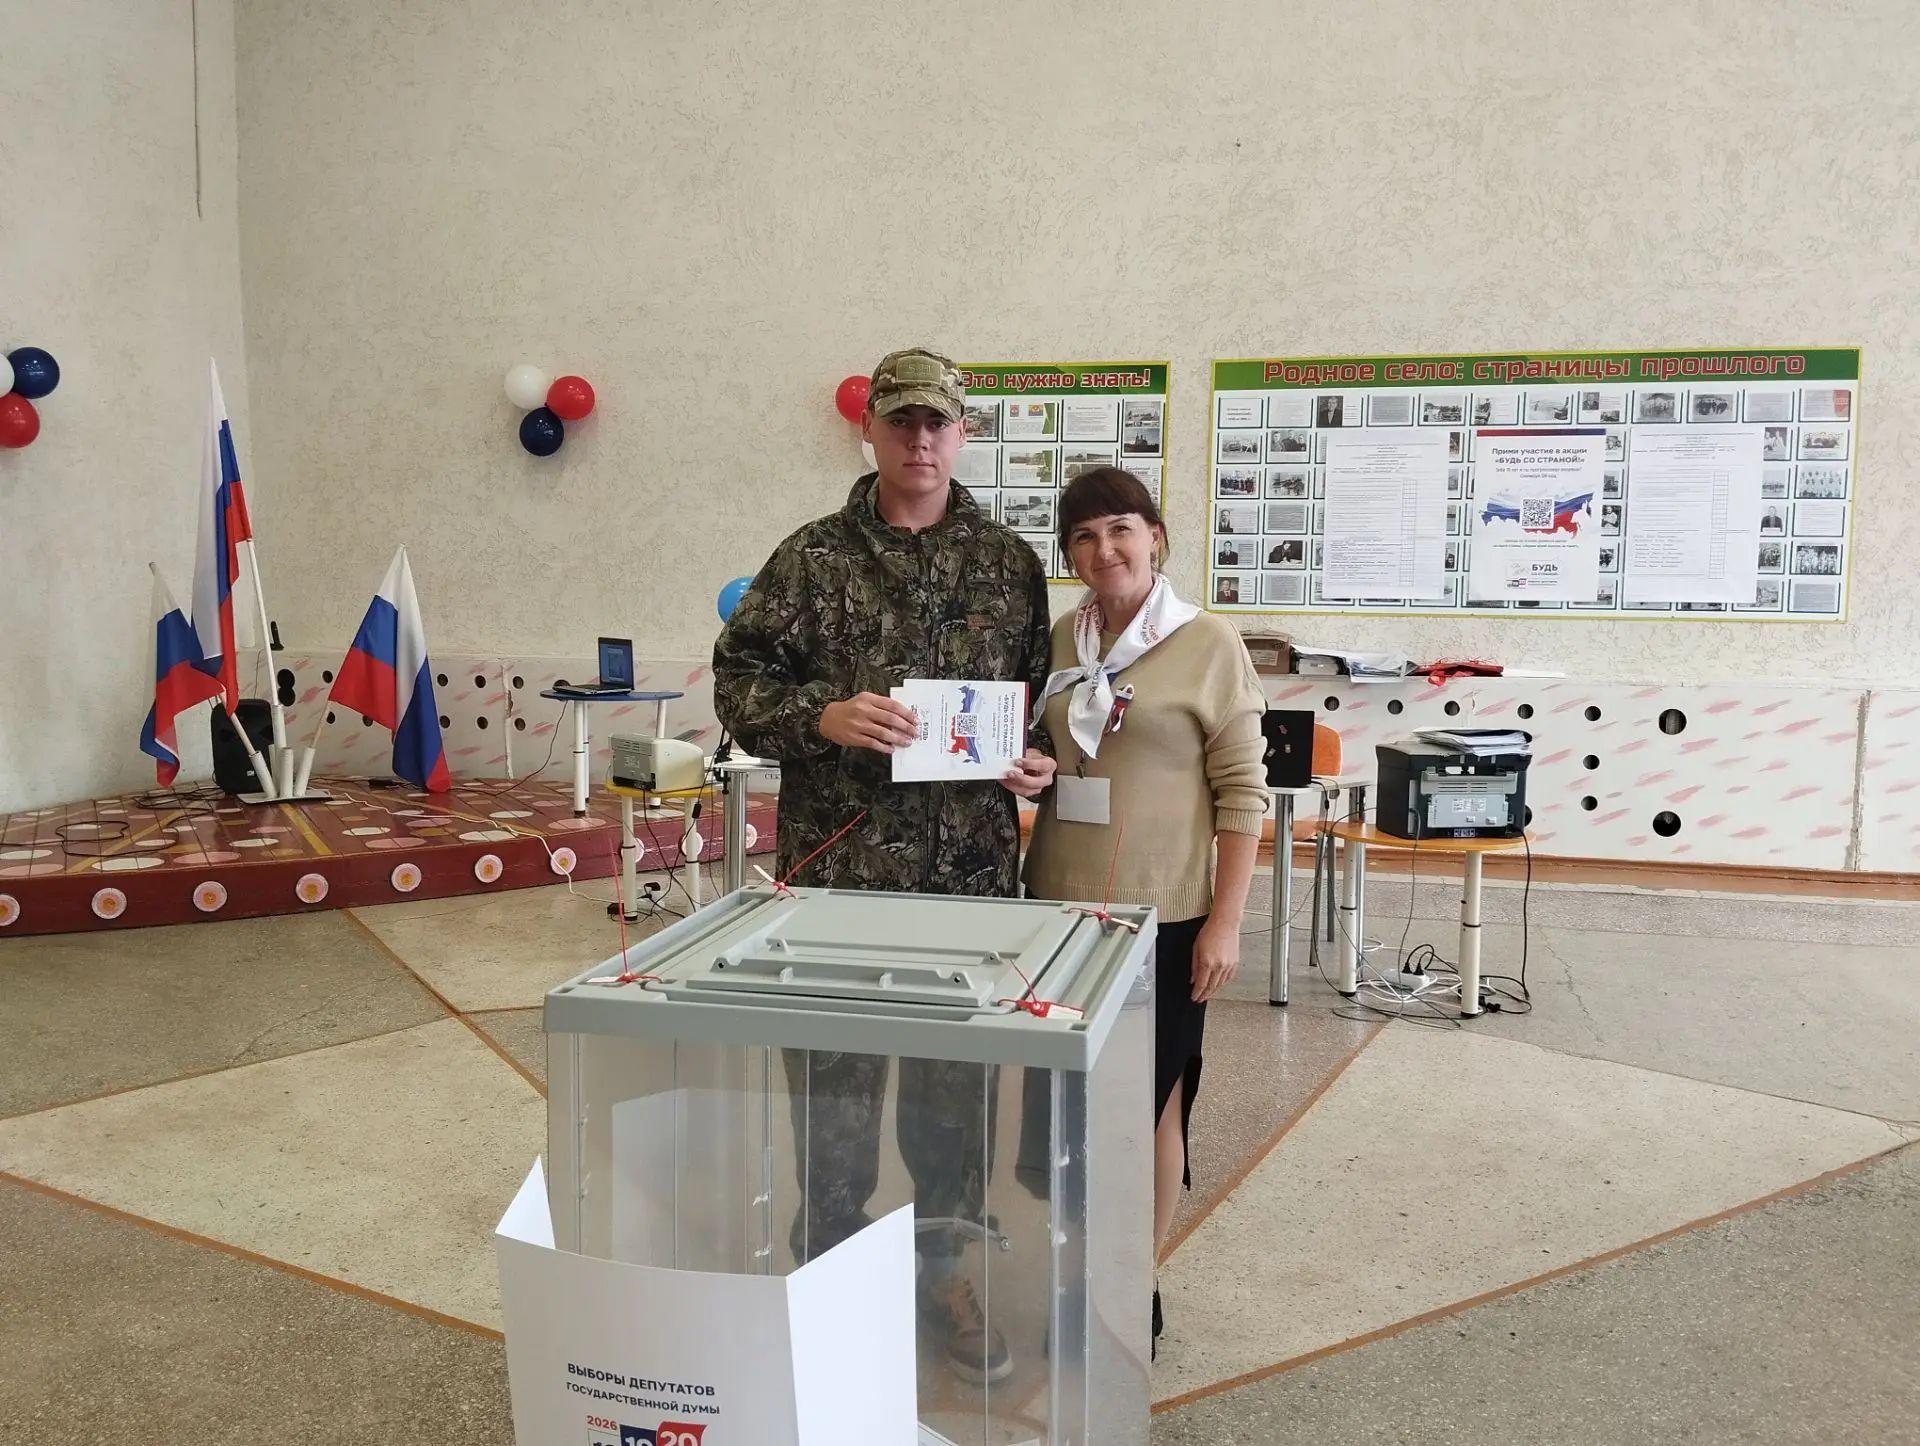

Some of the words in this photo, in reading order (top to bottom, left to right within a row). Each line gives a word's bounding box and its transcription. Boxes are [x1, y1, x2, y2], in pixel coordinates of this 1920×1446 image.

[1263, 360, 1376, 385] Родное
[1384, 361, 1464, 381] село:
[1473, 358, 1630, 383] страницы
[1641, 354, 1806, 381] прошлого
[961, 370, 998, 389] Это
[1004, 371, 1075, 393] нужно
[1080, 368, 1151, 388] знать!
[1492, 448, 1519, 456] Прими
[1520, 448, 1553, 456] участие
[1523, 456, 1535, 464] СО
[1532, 564, 1558, 572] БУДЬ
[567, 1363, 625, 1386] ВЫБОРЫ
[629, 1376, 715, 1396] ДЕПУТАТОВ
[566, 1381, 679, 1412] ГОСУДАРСТВЕННОЙ
[682, 1404, 720, 1415] ДУМЫ
[587, 1415, 618, 1431] 2026
